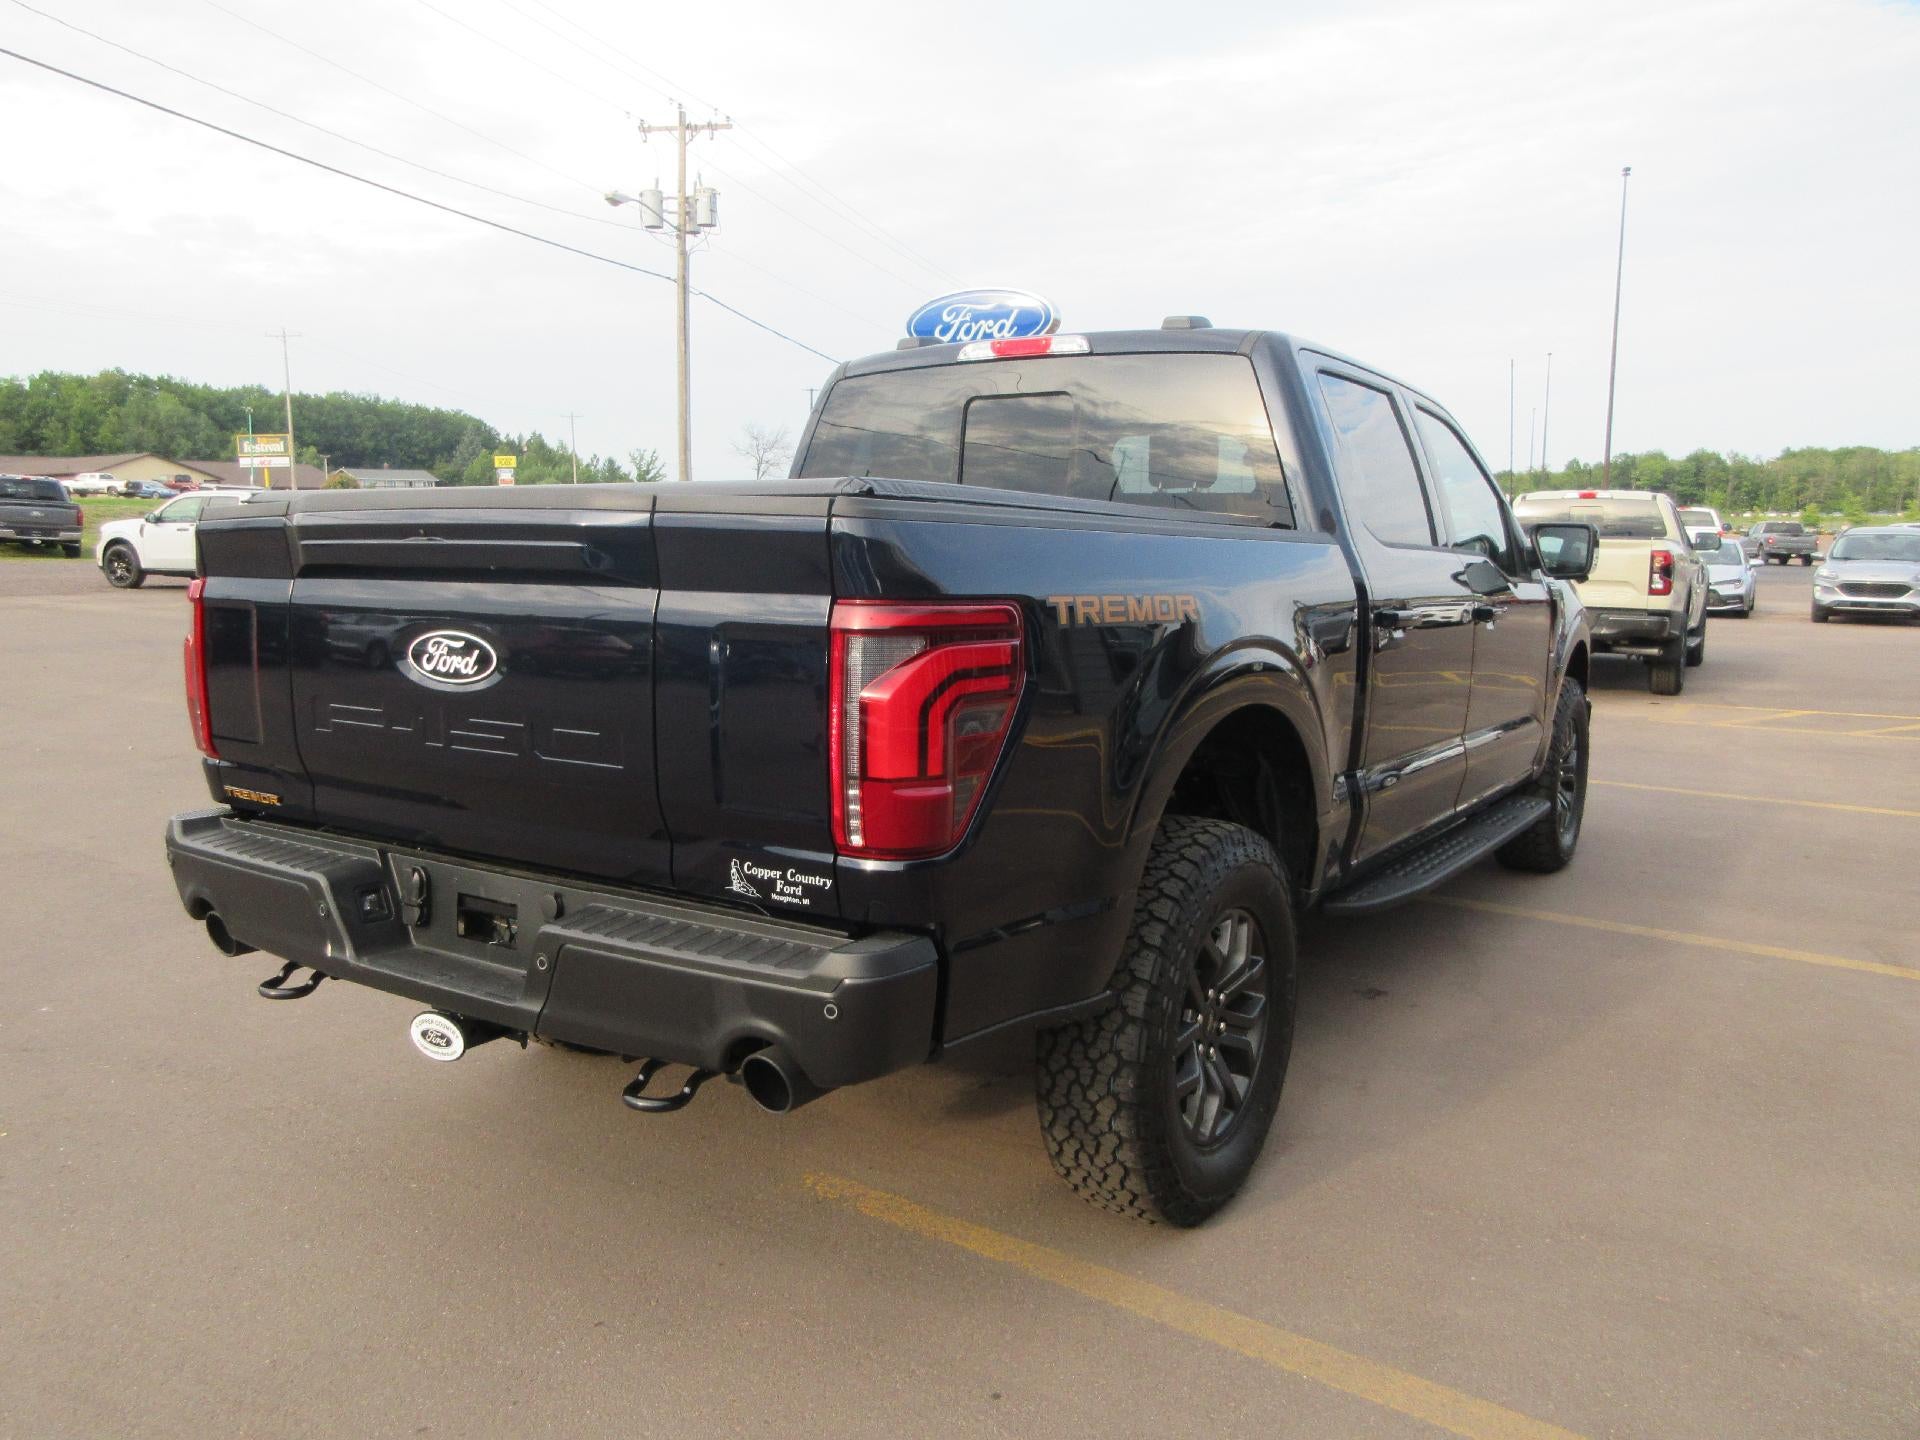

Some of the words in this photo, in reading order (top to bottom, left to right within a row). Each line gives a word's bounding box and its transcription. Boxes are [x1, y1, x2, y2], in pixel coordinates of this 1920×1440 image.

[934, 302, 1018, 343] Ford
[1047, 595, 1198, 626] TREMOR
[422, 637, 480, 676] Ford
[224, 785, 281, 806] TREMOR
[744, 862, 782, 880] Copper
[787, 869, 832, 889] Country
[771, 892, 802, 905] Houghton,
[776, 880, 802, 896] Ford
[426, 1030, 447, 1046] Ford
